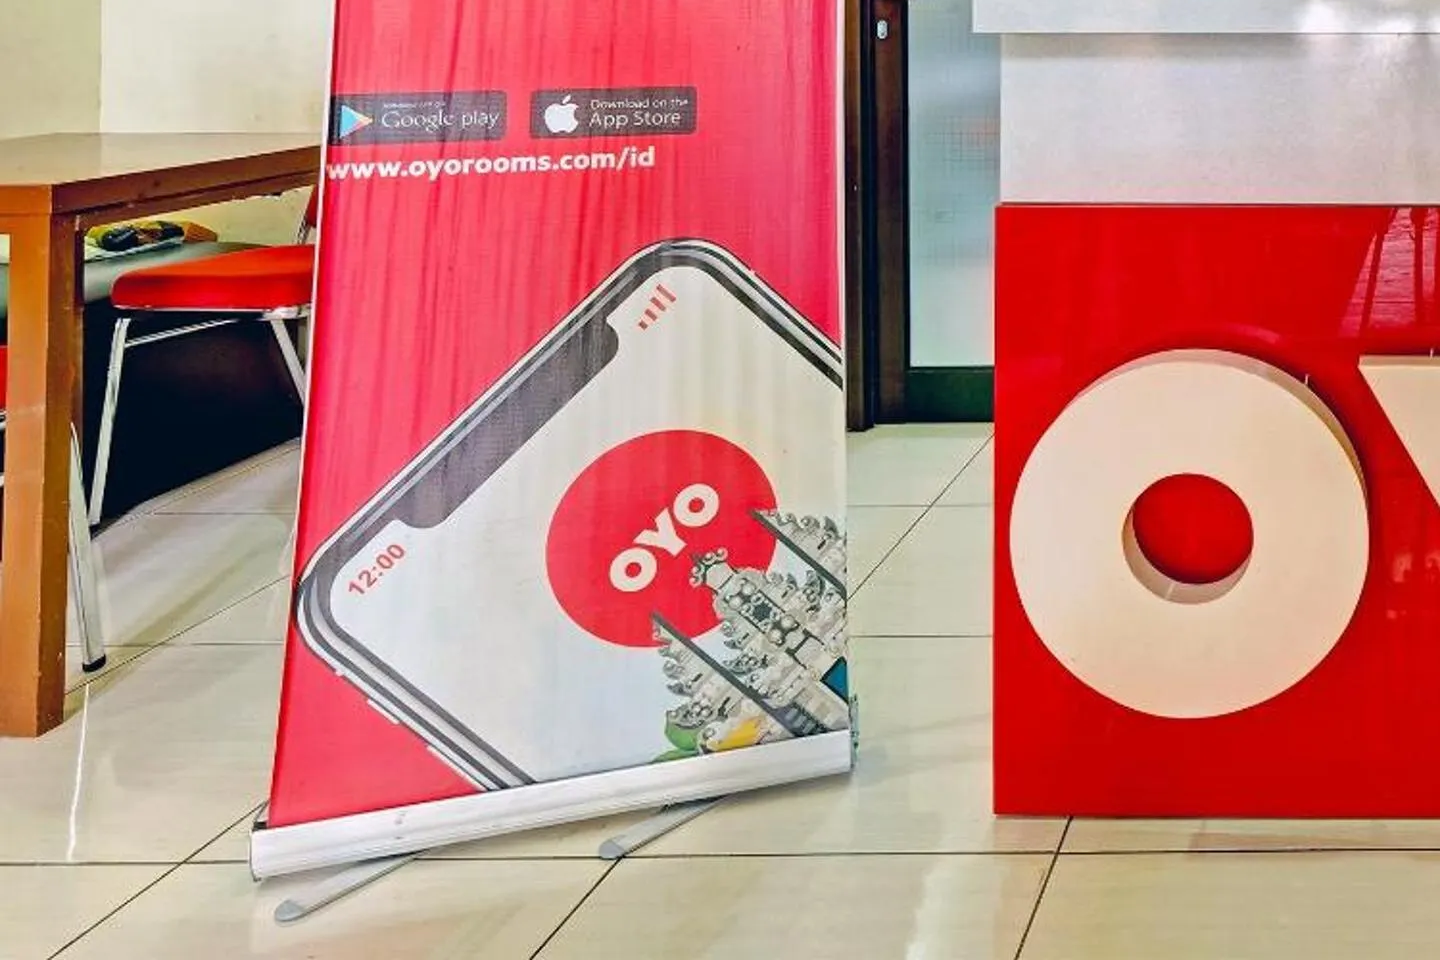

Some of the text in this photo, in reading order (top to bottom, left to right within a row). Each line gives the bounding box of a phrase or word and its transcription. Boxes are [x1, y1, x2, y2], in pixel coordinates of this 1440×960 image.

[590, 97, 650, 111] Download
[381, 109, 499, 133] Google play
[589, 110, 681, 129] App Store
[327, 146, 656, 181] www.oyorooms.com/id
[610, 483, 719, 591] OYO
[347, 543, 406, 596] 12:00
